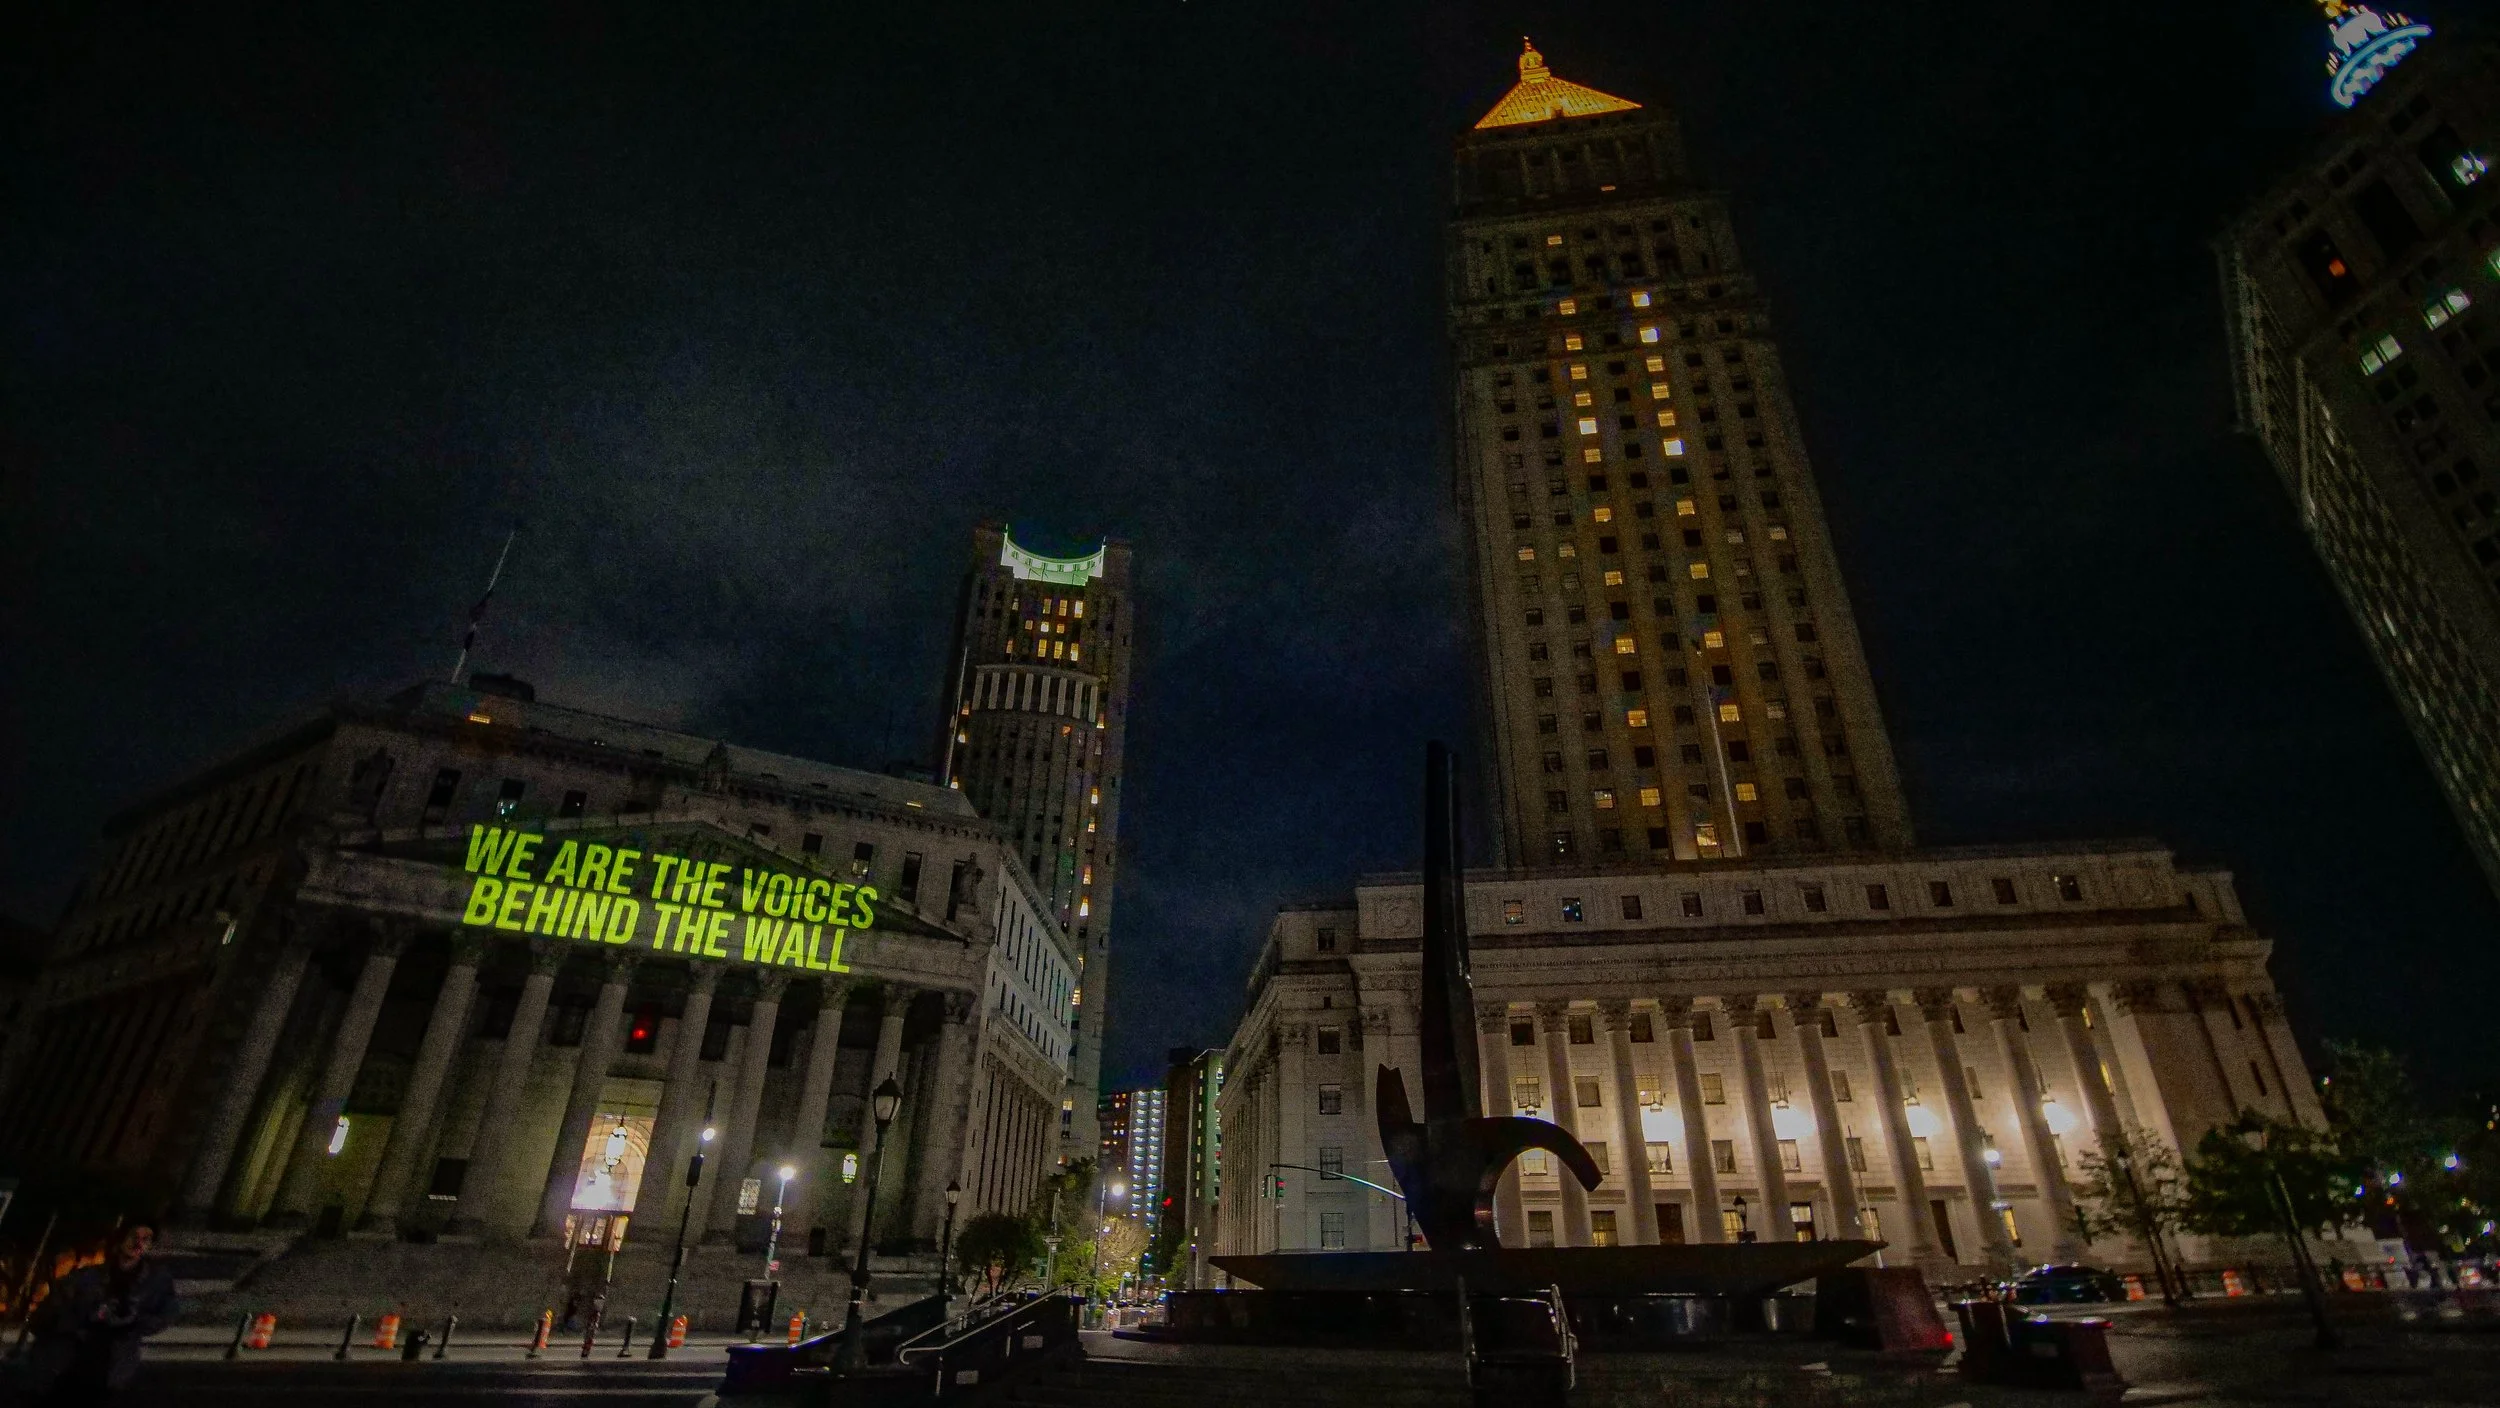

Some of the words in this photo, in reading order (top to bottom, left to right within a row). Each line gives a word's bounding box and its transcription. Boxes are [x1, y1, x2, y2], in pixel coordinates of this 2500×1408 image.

[462, 876, 641, 945] BEHIND
[652, 901, 736, 958] THE
[742, 915, 851, 974] WALL
[464, 824, 544, 881] WE
[544, 839, 642, 895] ARE
[651, 853, 733, 909] THE
[742, 868, 878, 930] VOICES
